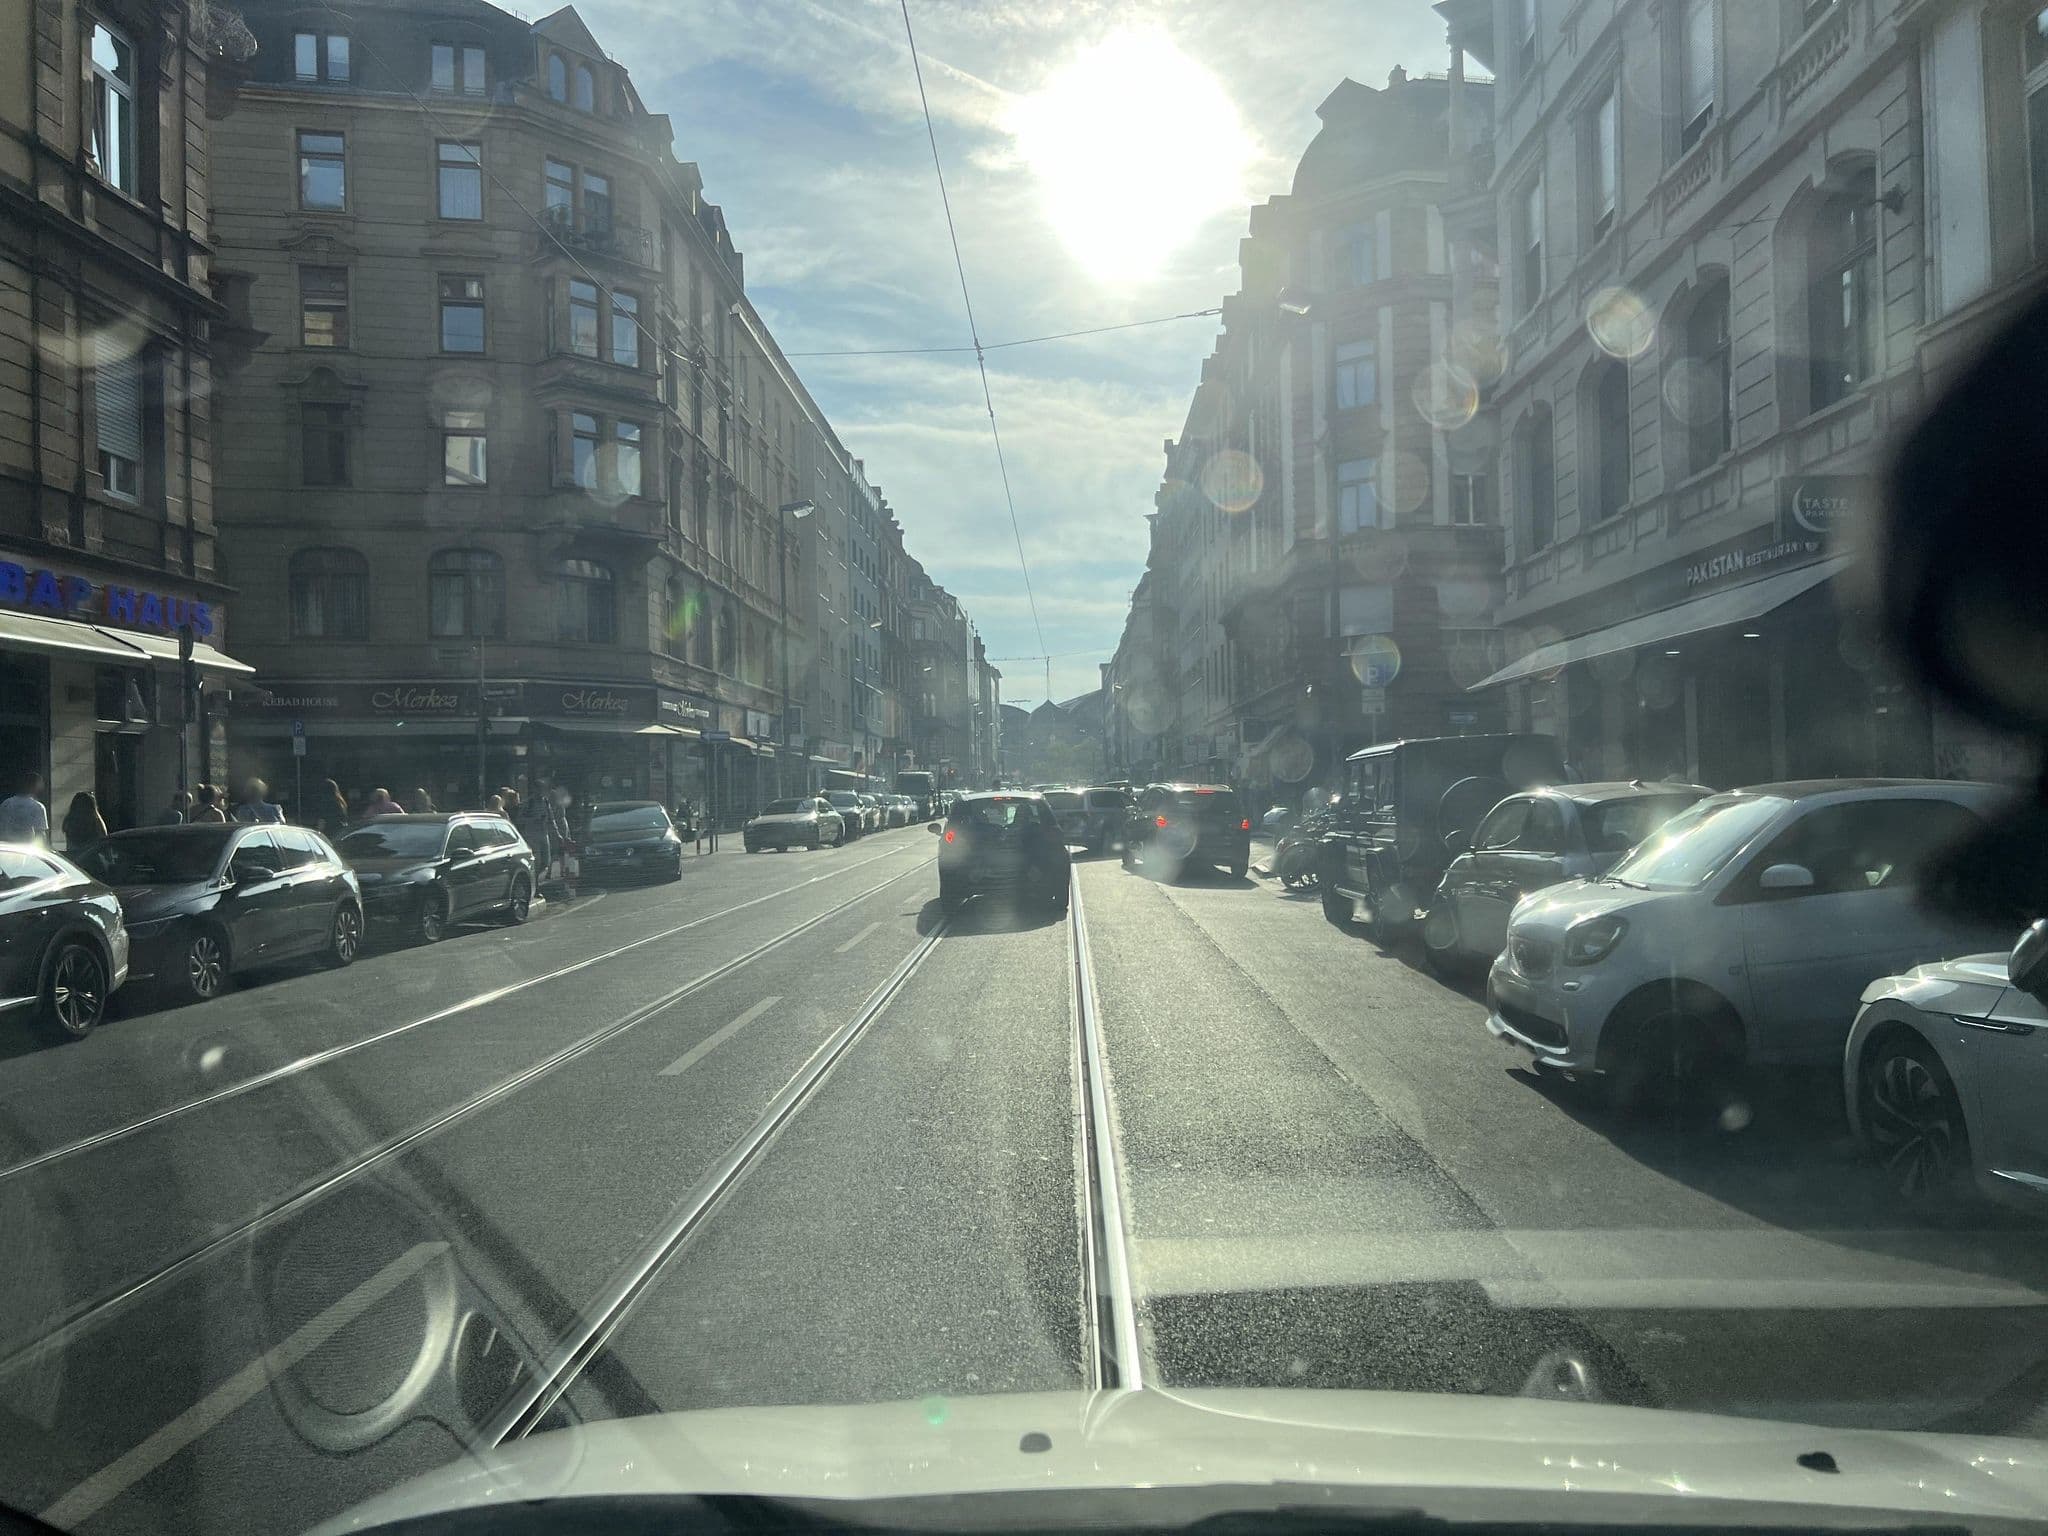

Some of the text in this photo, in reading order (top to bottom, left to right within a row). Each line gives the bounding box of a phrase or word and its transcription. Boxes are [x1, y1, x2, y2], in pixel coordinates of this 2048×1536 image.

[1687, 549, 1745, 586] PAKISTAN
[105, 583, 214, 637] HAUS
[371, 687, 458, 709] Merkez
[562, 690, 629, 711] Merkez
